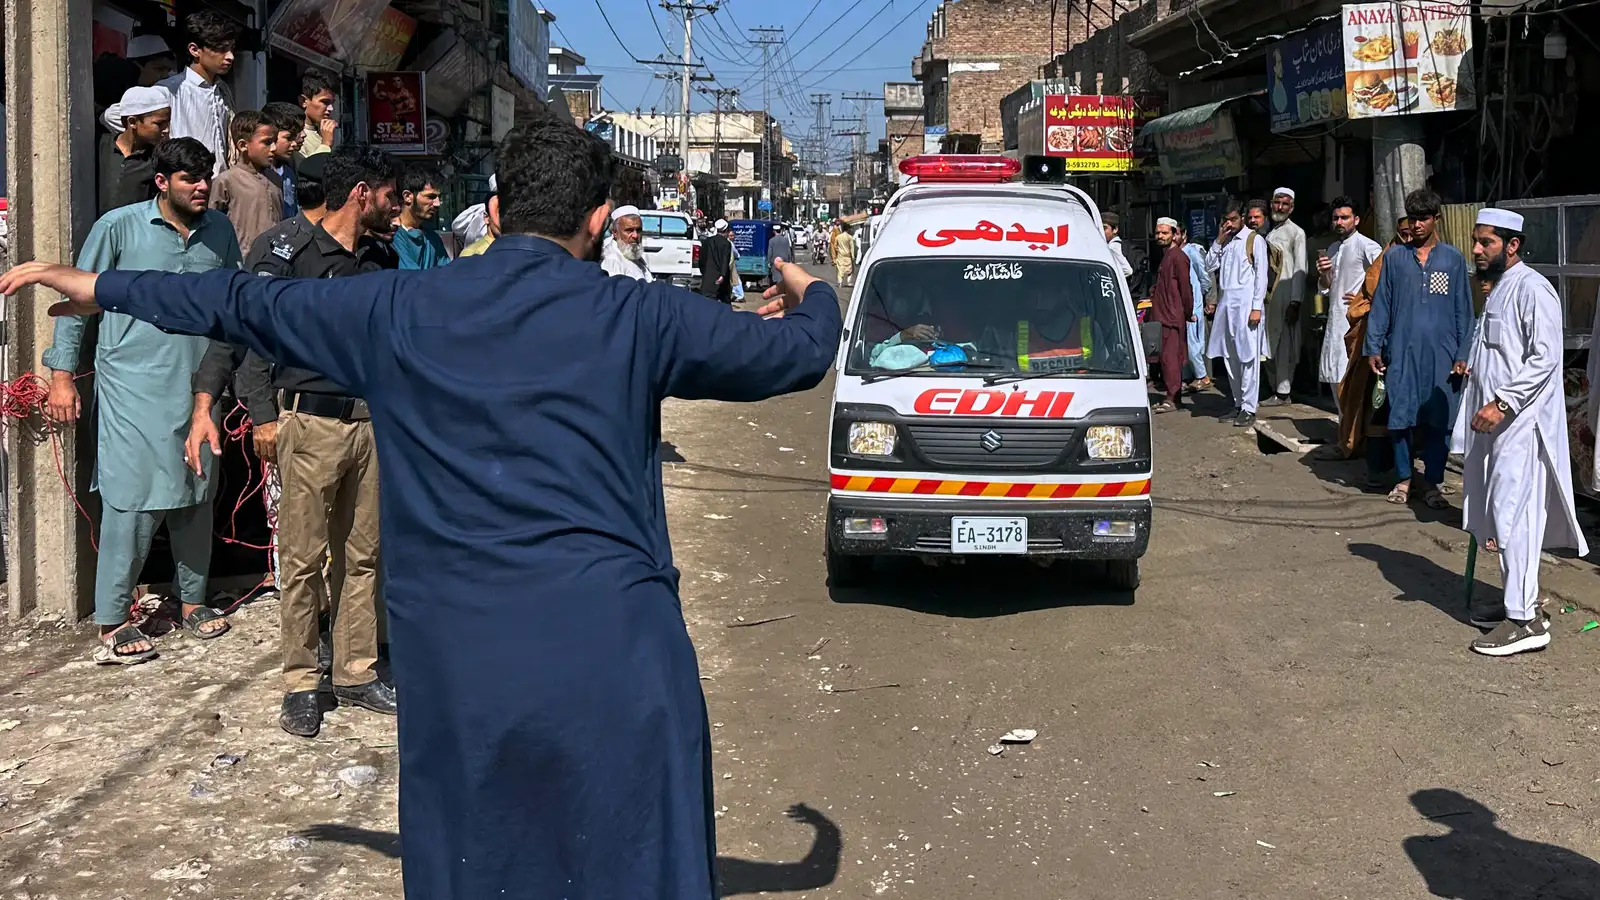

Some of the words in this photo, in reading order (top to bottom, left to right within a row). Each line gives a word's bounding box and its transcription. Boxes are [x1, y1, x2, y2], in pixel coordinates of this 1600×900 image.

[1348, 8, 1396, 26] ANAYA
[914, 388, 1075, 418] EDHI
[957, 527, 1022, 544] EA-3178
